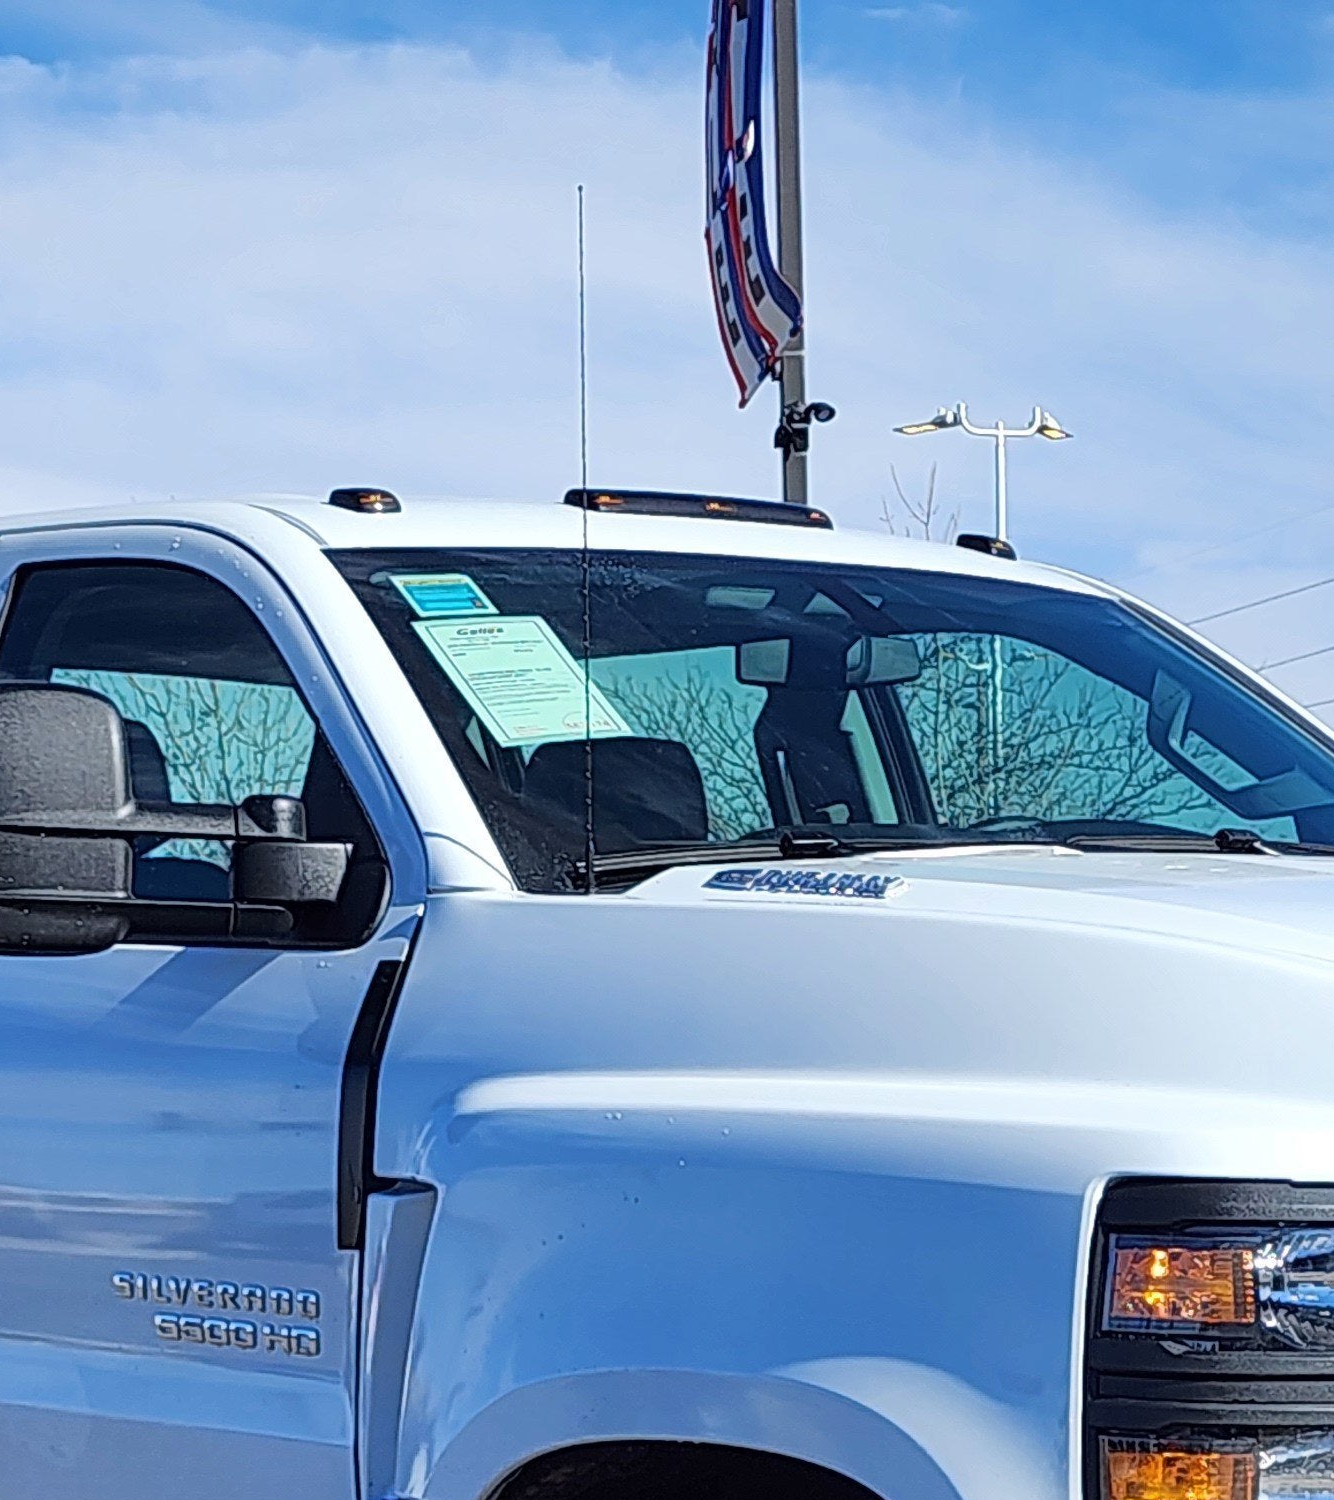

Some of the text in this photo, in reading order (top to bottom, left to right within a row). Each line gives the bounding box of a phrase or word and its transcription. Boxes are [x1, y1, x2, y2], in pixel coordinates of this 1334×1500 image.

[112, 1271, 322, 1320] SILVERADO
[153, 1311, 322, 1356] 5500 HD
